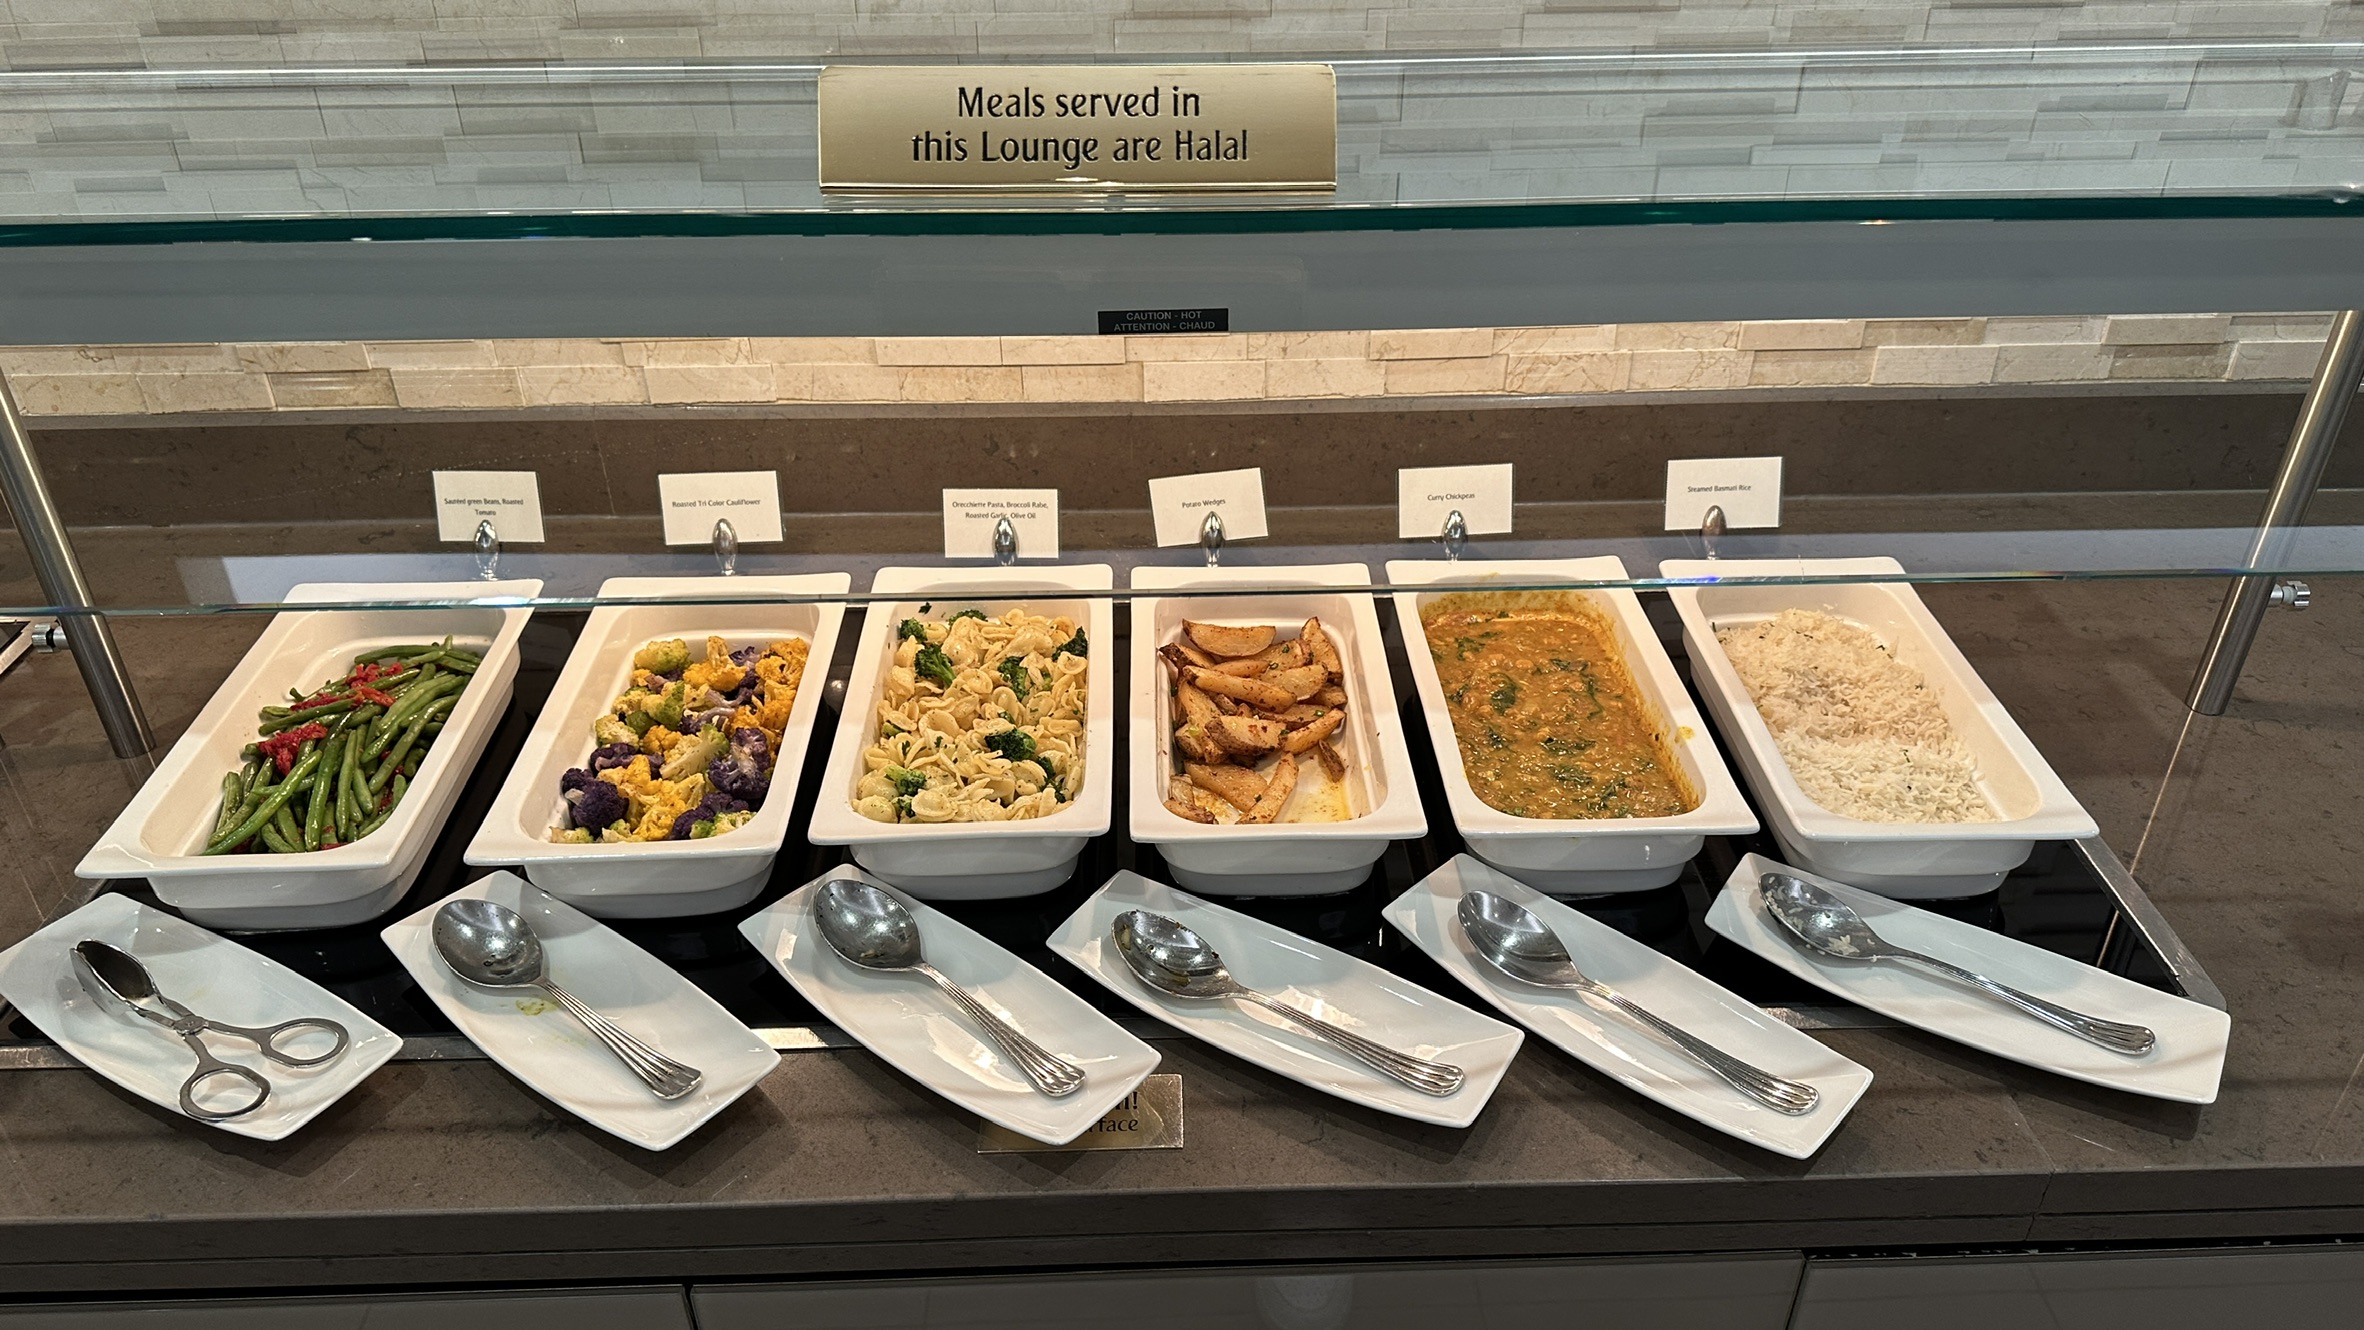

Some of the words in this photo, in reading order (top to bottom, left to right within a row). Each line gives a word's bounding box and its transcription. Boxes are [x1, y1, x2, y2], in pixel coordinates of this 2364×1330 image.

[957, 86, 1045, 118] Meals
[1055, 86, 1160, 118] served
[1172, 86, 1201, 118] in
[911, 131, 968, 163] this
[981, 131, 1099, 170] Lounge
[1112, 136, 1162, 162] are
[1174, 130, 1249, 162] Halal
[1126, 311, 1171, 321] CAUTION
[1181, 311, 1202, 319] HOT
[1113, 322, 1170, 332] ATTENTION
[1179, 321, 1216, 330] CHAUD
[467, 499, 483, 507] green
[502, 498, 524, 506] Roasted
[726, 499, 761, 507] Cauliflower
[952, 501, 986, 509] Orecchiette
[987, 501, 1006, 509] Pasta,
[1006, 501, 1031, 509] Broccoli
[1202, 499, 1226, 507] Wedges
